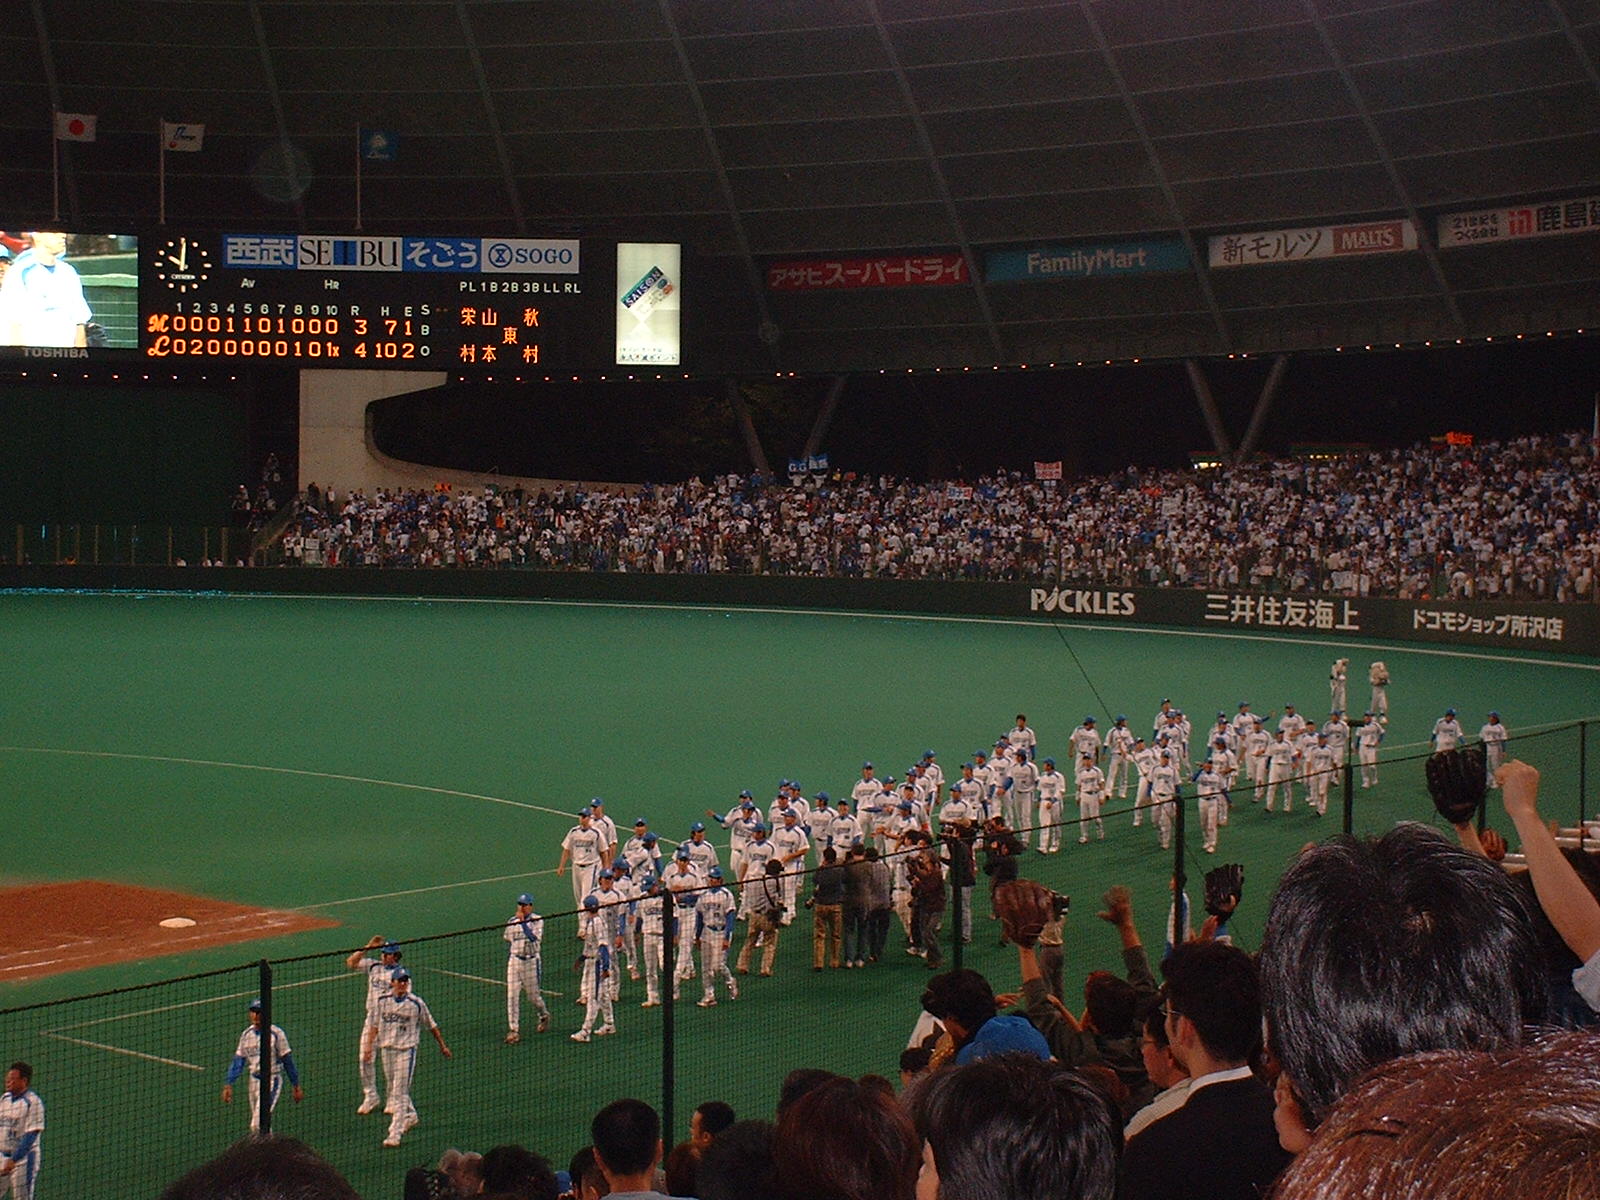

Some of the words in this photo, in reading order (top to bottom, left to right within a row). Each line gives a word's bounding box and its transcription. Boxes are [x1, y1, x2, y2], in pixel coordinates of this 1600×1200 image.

[227, 237, 294, 265] 西武
[299, 239, 399, 267] SEIBU
[406, 241, 478, 268] そごう
[515, 248, 573, 265] SOGO
[1027, 247, 1147, 275] FamilyMart
[1223, 231, 1323, 263] 新モルツ
[1342, 228, 1394, 250] MALTS
[460, 281, 477, 292] PL
[481, 281, 498, 292] 1B
[502, 281, 519, 293] 2B
[523, 282, 540, 293] 3B
[543, 283, 560, 293] LL
[564, 283, 581, 293] RL
[771, 256, 965, 287] アサヒスーパードライ
[623, 269, 661, 307] SAISON
[22, 347, 89, 359] TOSHIBA
[1030, 585, 1136, 616] PICKLES
[1204, 594, 1360, 630] 三井住友海上
[1413, 609, 1564, 641] ドコモショップ所沢店
